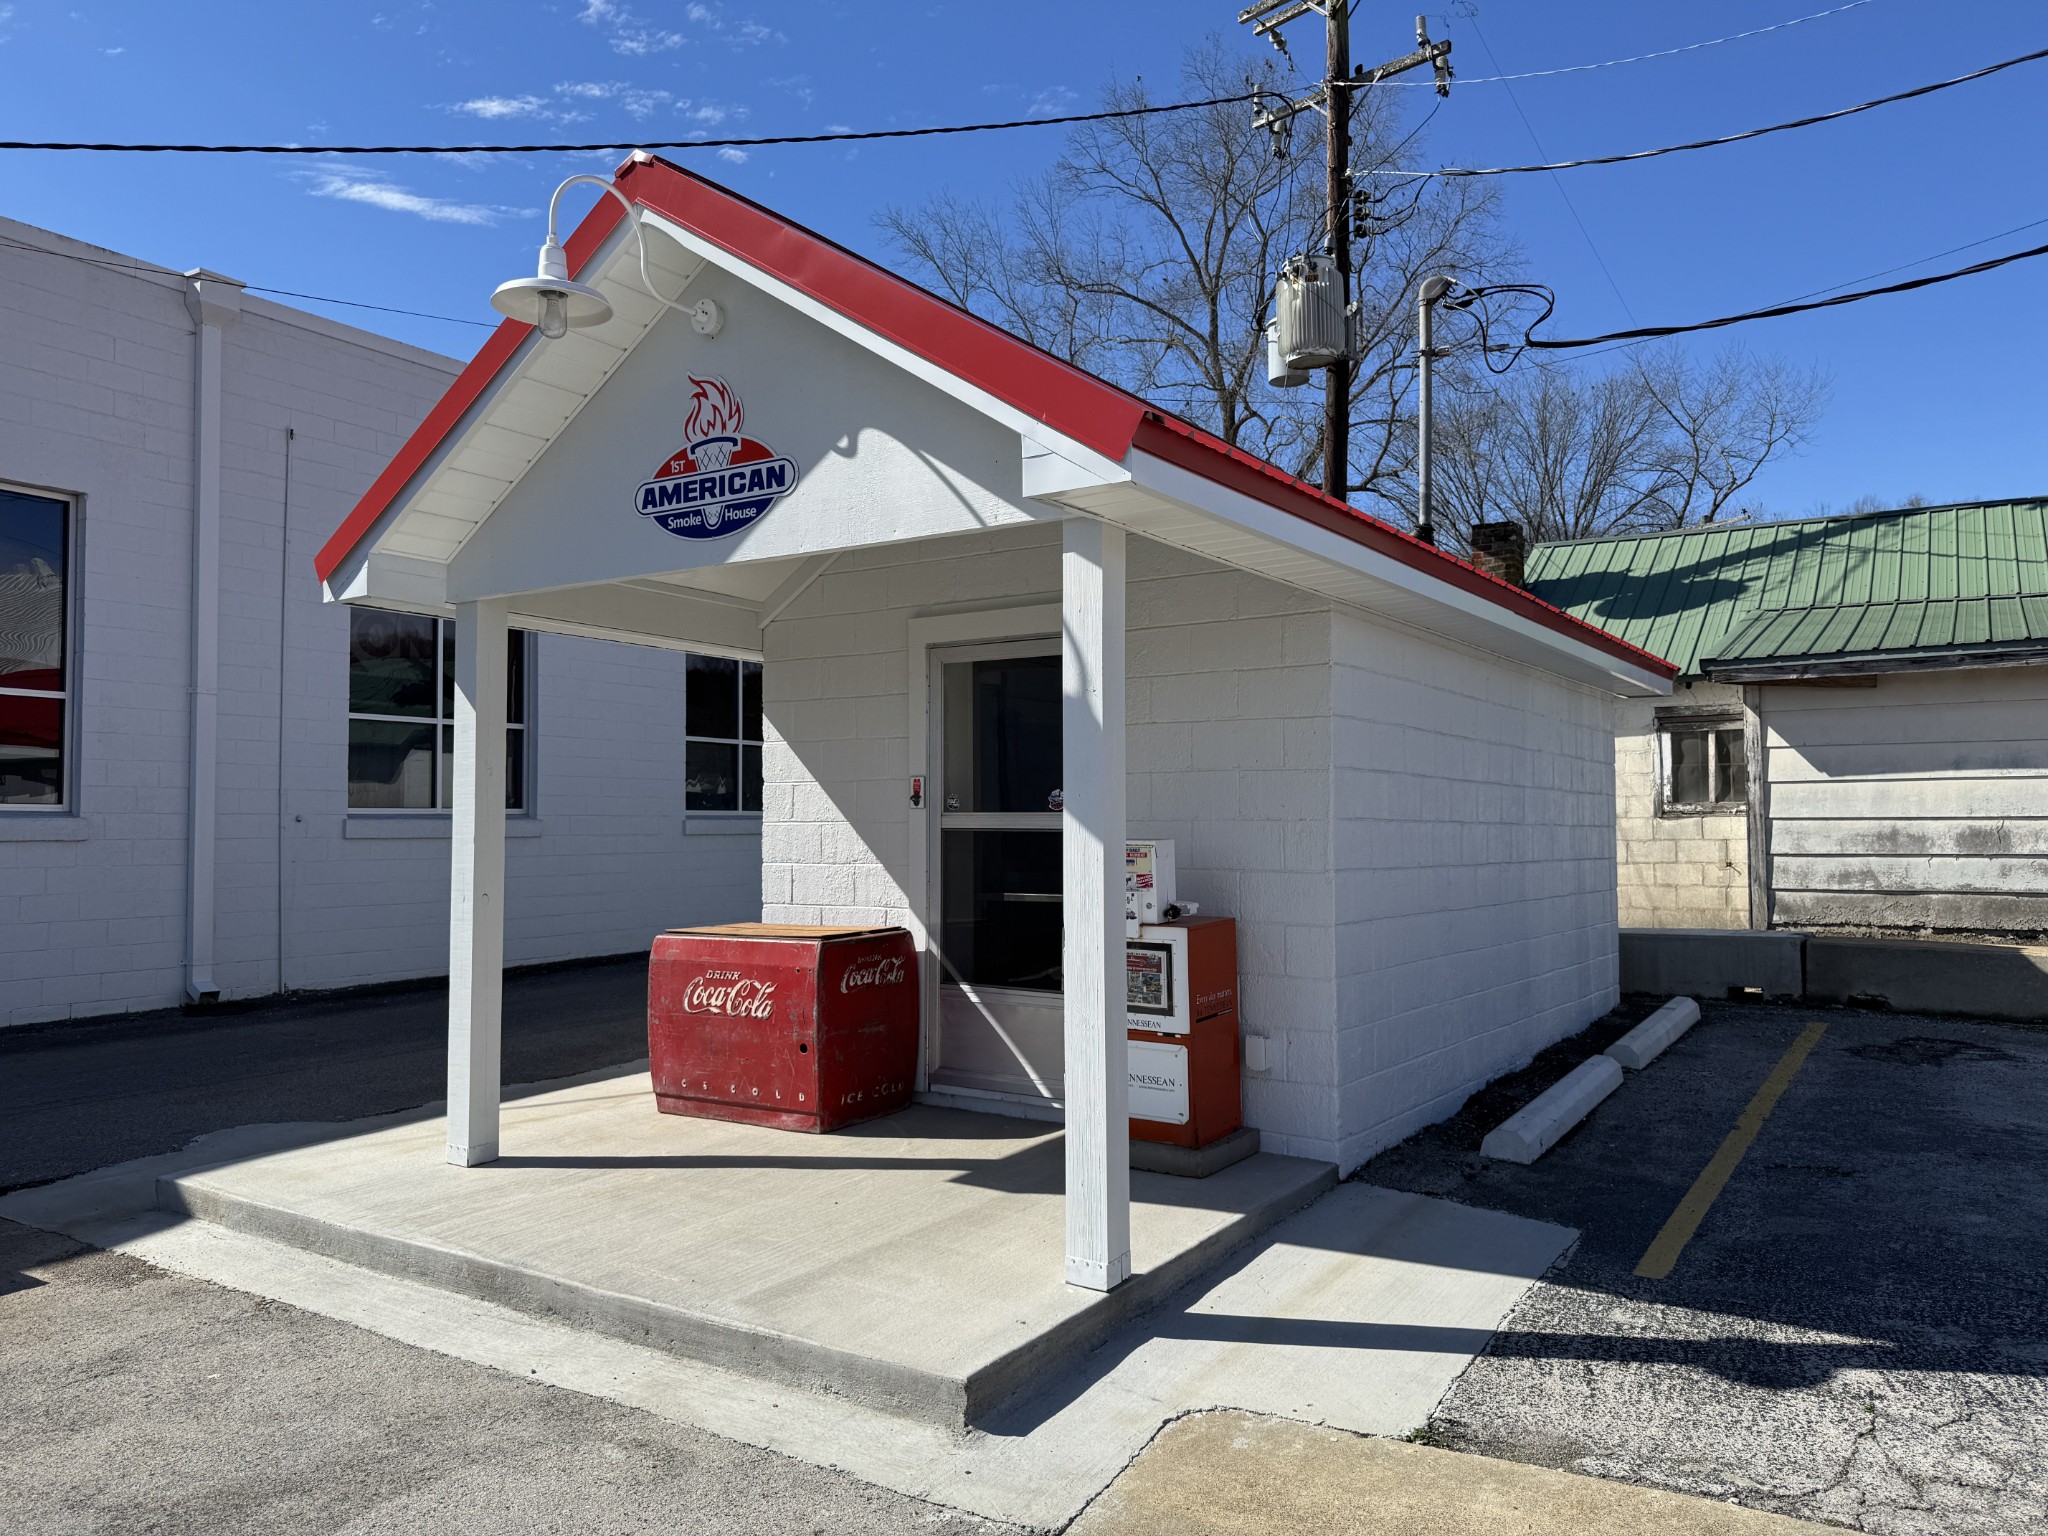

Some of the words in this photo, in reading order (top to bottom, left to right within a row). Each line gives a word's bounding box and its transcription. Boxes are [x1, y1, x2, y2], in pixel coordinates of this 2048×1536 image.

[670, 460, 686, 474] 1ST
[641, 464, 786, 511] AMERICAN
[667, 513, 702, 530] Smoke
[724, 507, 757, 522] House
[705, 969, 741, 981] DRINK
[840, 955, 906, 994] Coca-Cola
[683, 976, 778, 1019] Coca-Cola
[1127, 1018, 1162, 1029] NNESSEAN
[1128, 1073, 1175, 1087] NNESSEAN
[730, 1084, 805, 1102] COLD
[841, 1090, 864, 1107] ICE
